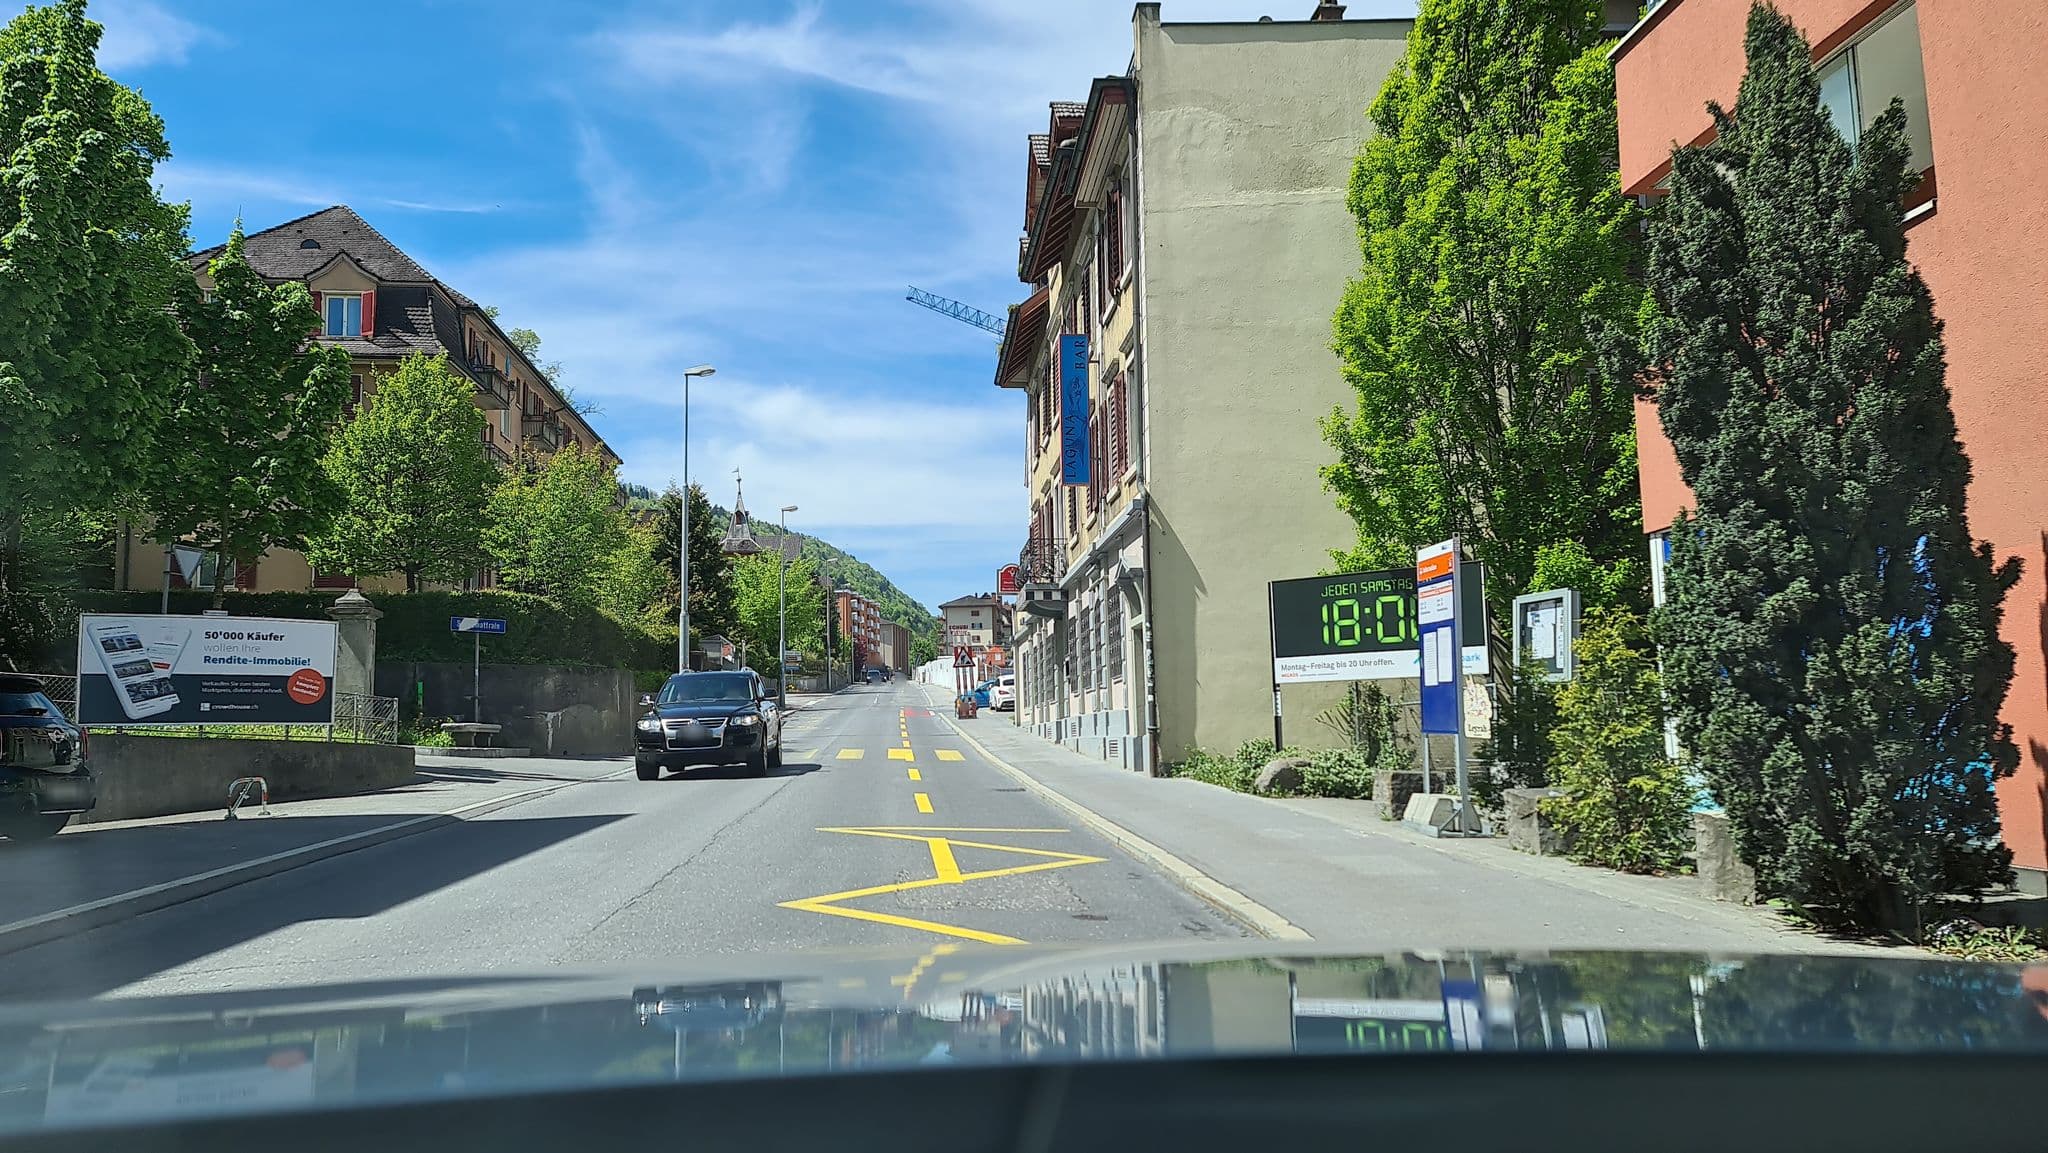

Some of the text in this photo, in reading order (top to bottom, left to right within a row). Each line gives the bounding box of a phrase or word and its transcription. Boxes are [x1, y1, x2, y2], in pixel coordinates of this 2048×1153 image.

[1074, 340, 1086, 370] BAR
[1360, 579, 1414, 594] SAMSTAG
[204, 631, 285, 641] 50'000 Käufer
[203, 643, 261, 653] wollen Ihre
[203, 655, 311, 666] Rendite-Immobilie!
[1336, 661, 1347, 669] bis
[1348, 660, 1358, 668] 20
[1359, 659, 1372, 667] Uhr
[1373, 658, 1395, 667] offen.
